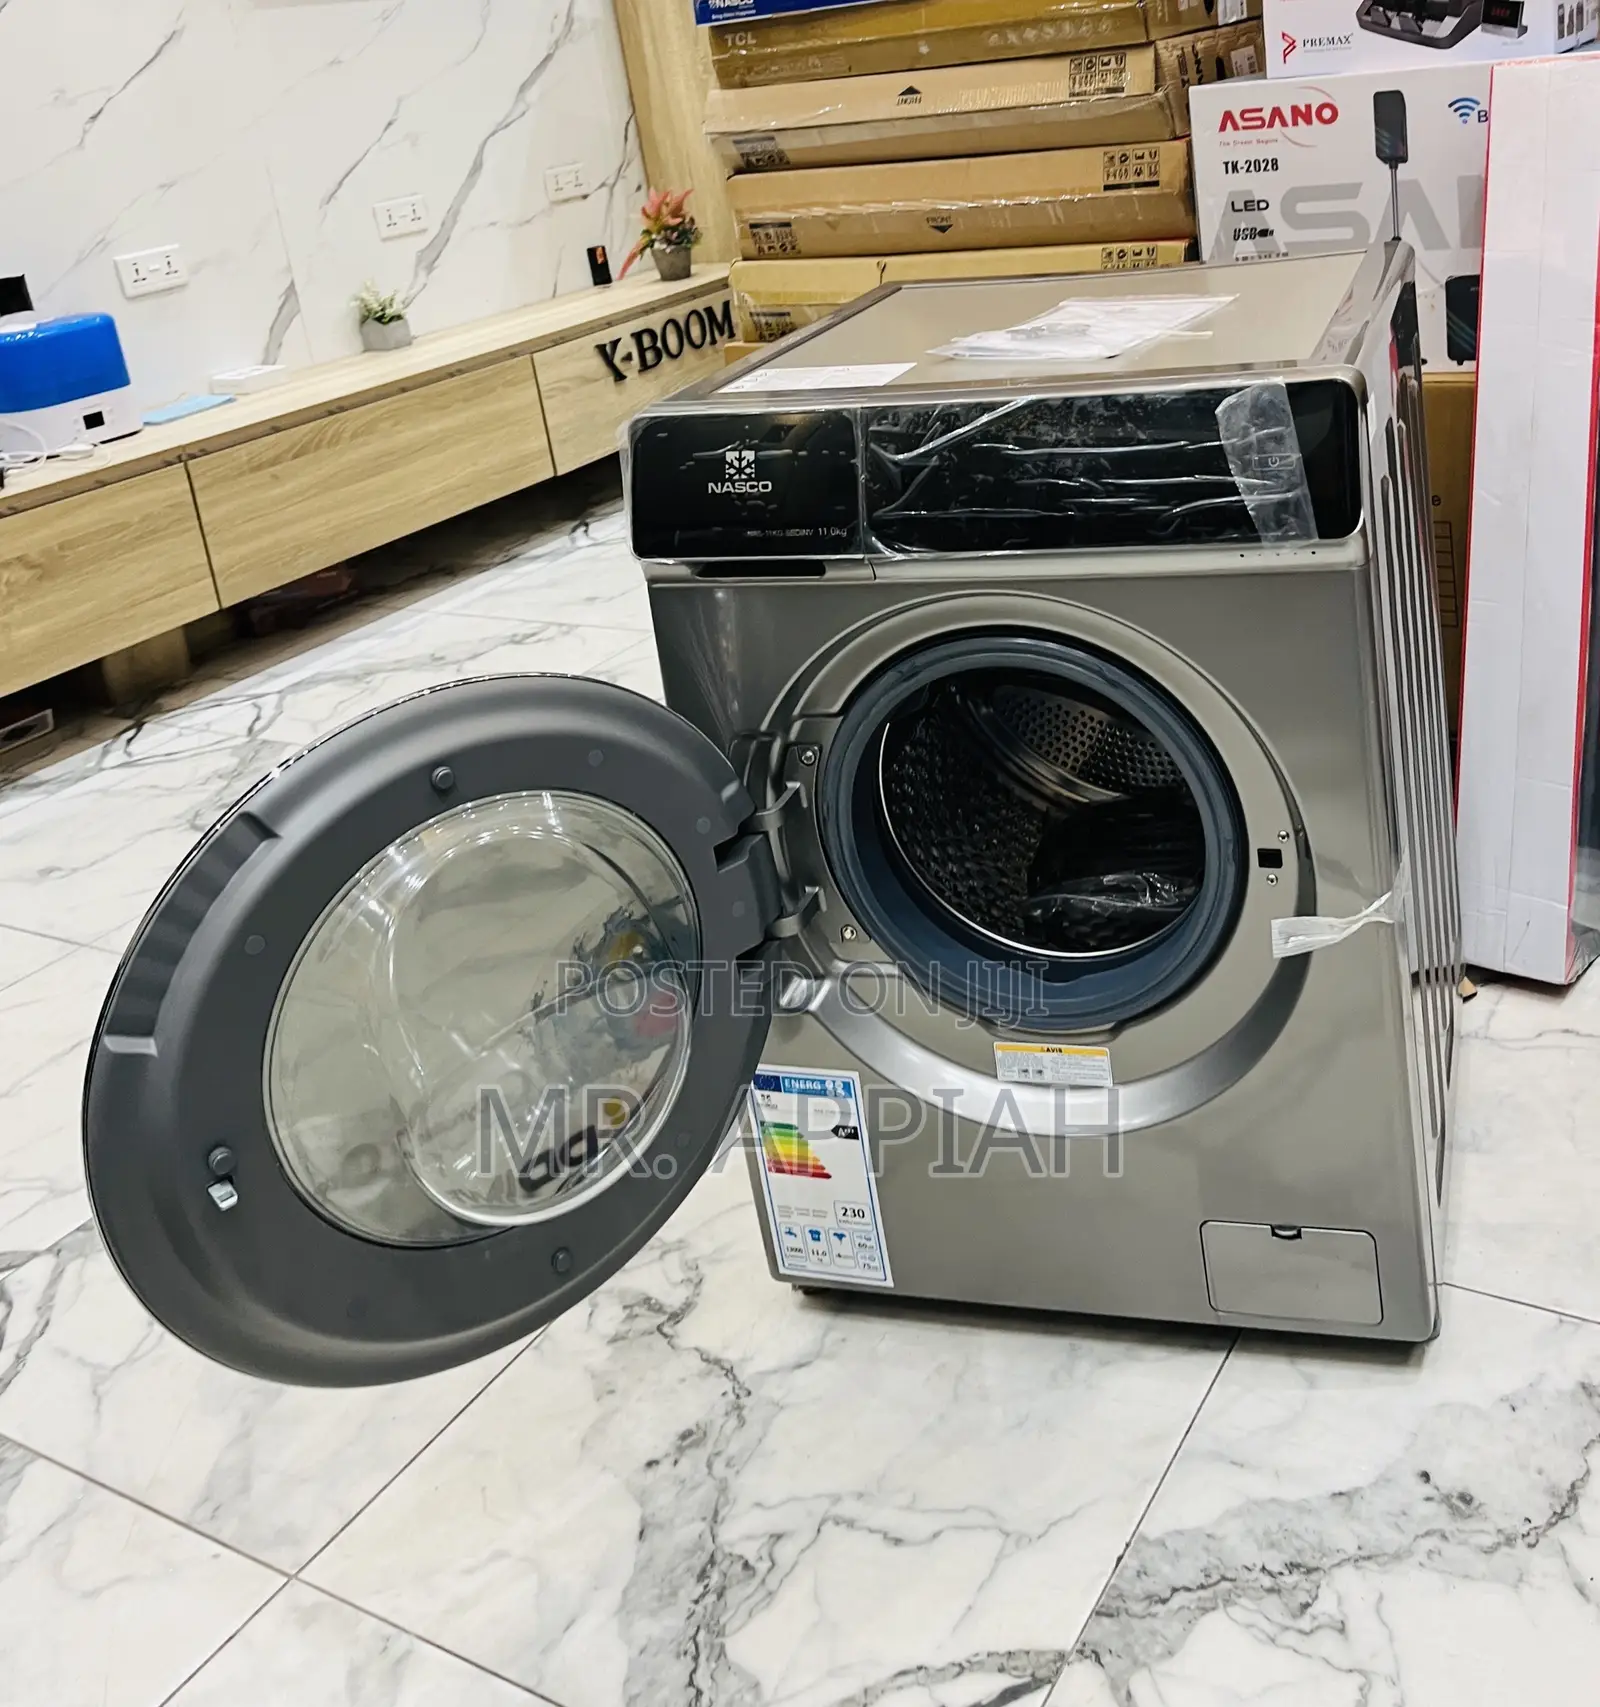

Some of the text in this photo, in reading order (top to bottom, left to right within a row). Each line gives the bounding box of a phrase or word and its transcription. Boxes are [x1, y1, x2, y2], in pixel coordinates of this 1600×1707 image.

[724, 31, 757, 47] TCL
[1302, 36, 1352, 48] PREMAX
[1218, 102, 1339, 133] ASANO
[1222, 157, 1280, 175] TK-2028
[1231, 199, 1270, 213] LED
[1233, 227, 1258, 241] USB
[708, 480, 773, 494] NASCO
[784, 1078, 821, 1090] ENERG
[841, 1206, 865, 1219] 230
